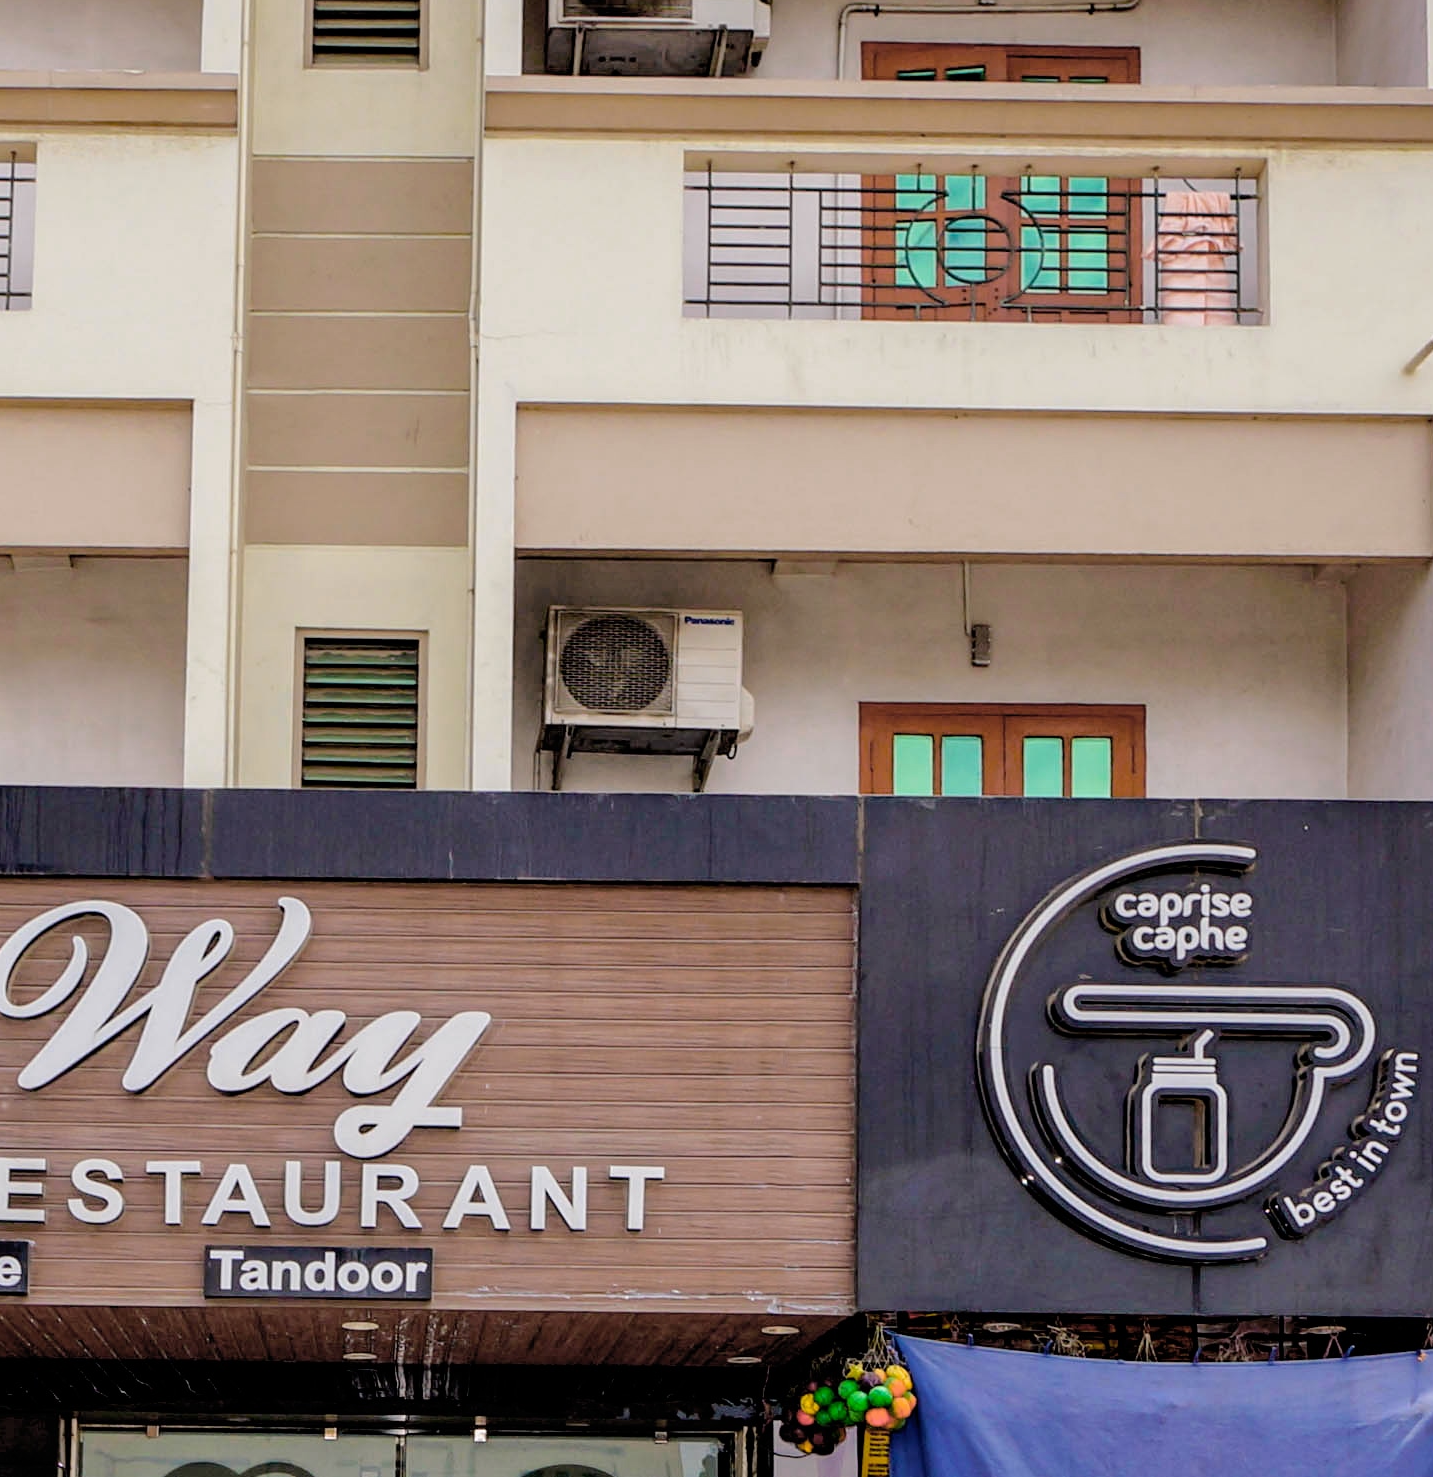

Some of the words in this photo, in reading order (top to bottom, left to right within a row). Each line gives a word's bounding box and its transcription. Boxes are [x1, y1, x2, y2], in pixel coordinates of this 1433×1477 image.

[1115, 884, 1253, 926] caprise
[1132, 917, 1248, 960] caphe
[1369, 1051, 1419, 1136] town
[1349, 1140, 1390, 1173] in
[1283, 1165, 1364, 1227] best
[209, 1249, 428, 1293] Tandoor
